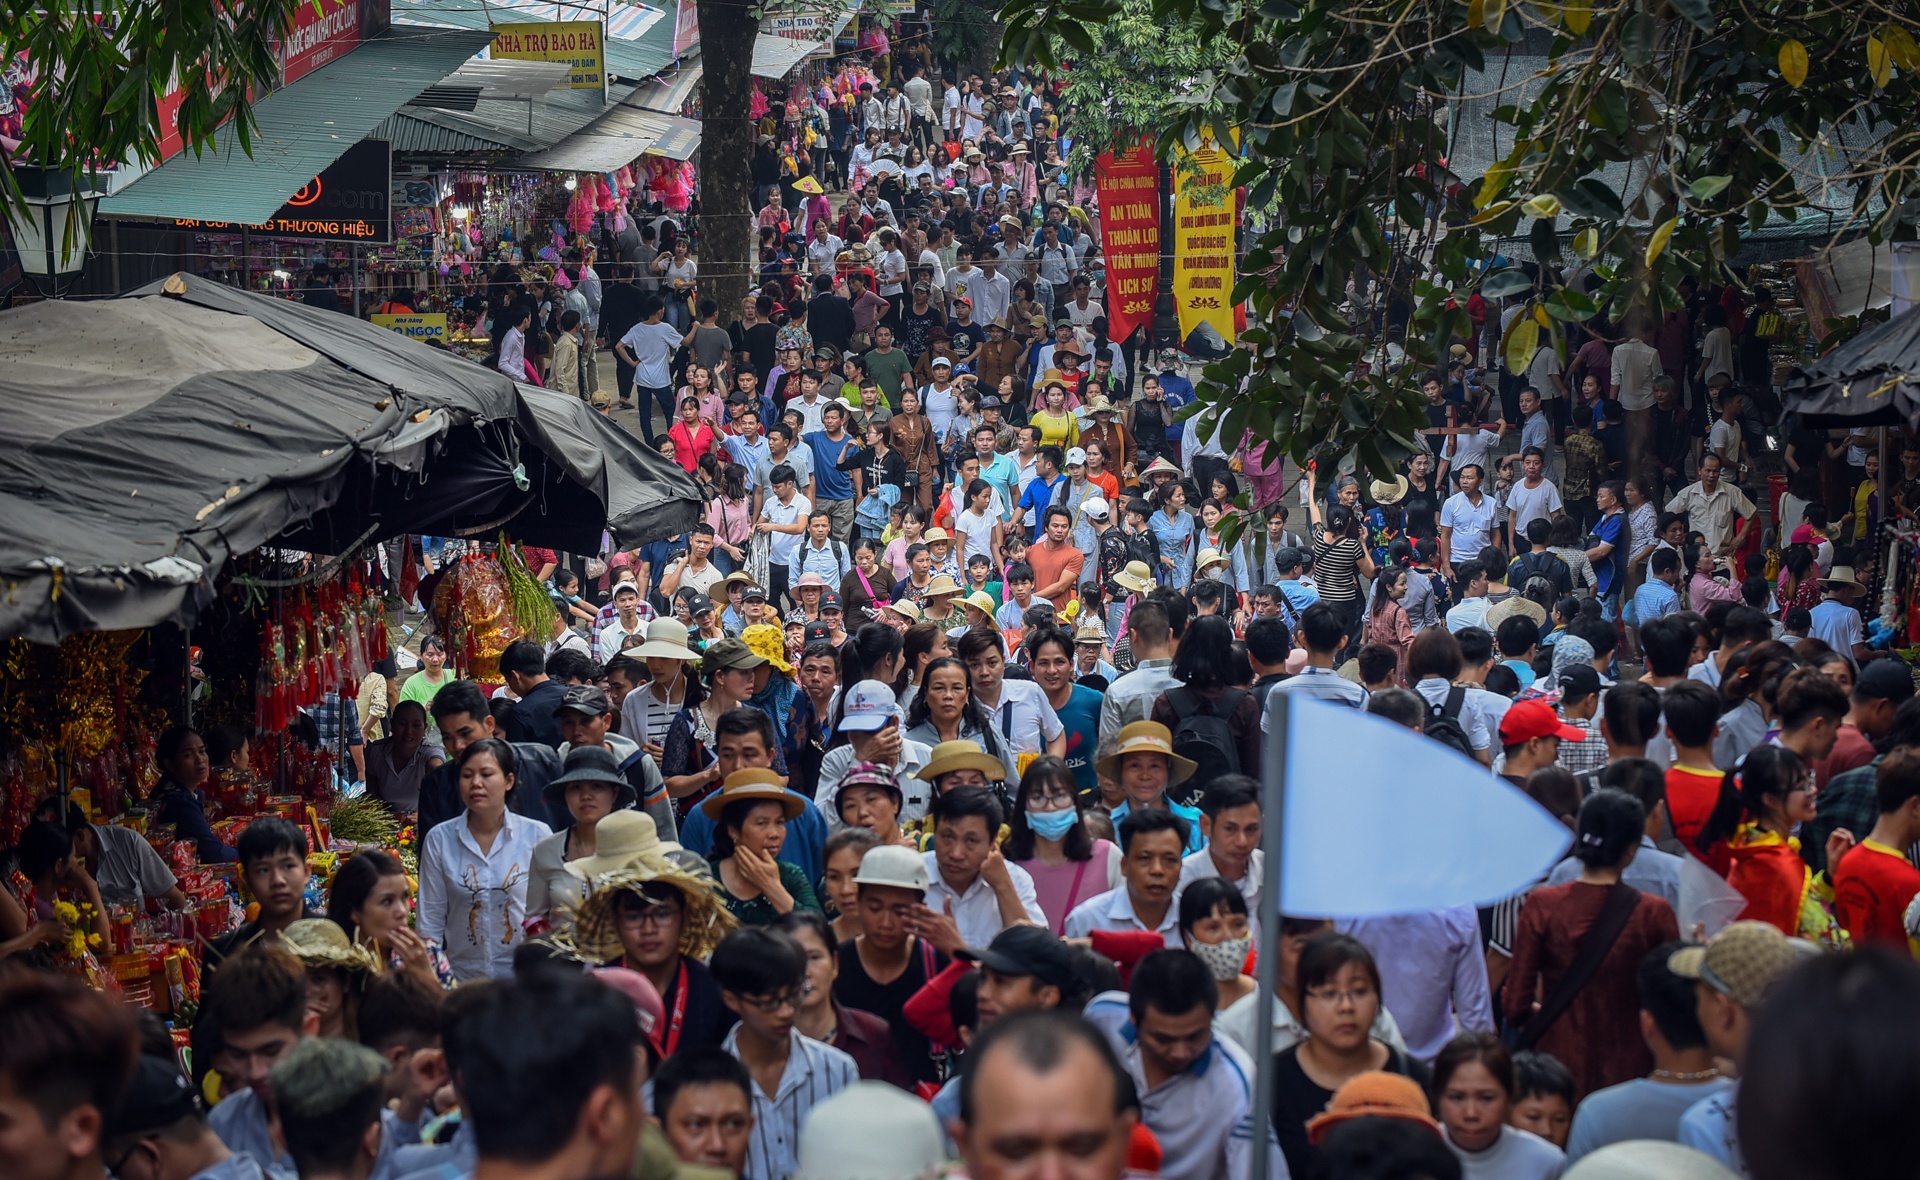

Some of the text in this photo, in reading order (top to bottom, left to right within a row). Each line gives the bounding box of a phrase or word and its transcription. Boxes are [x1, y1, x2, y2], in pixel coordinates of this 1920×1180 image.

[286, 25, 304, 59] NƯỚC
[305, 17, 317, 49] GIẢI
[333, 4, 344, 35] CÁC
[345, 1, 357, 31] LOẠI
[796, 18, 813, 28] TRỌ
[495, 26, 597, 56] NHÀ TRỌ BẢO HÀ
[585, 73, 599, 83] TRƯA
[1100, 175, 1155, 193] LỄ HỘI CHÙA HƯƠNG
[1110, 201, 1152, 221] AN TOÀN
[277, 219, 340, 234] THƯƠNG
[342, 220, 375, 237] HIỆU
[1108, 226, 1158, 248] THUẬN LỢI
[1111, 251, 1158, 270] VĂN MINH
[1118, 275, 1155, 298] LỊCH SỰ
[406, 326, 443, 339] NGỌC
